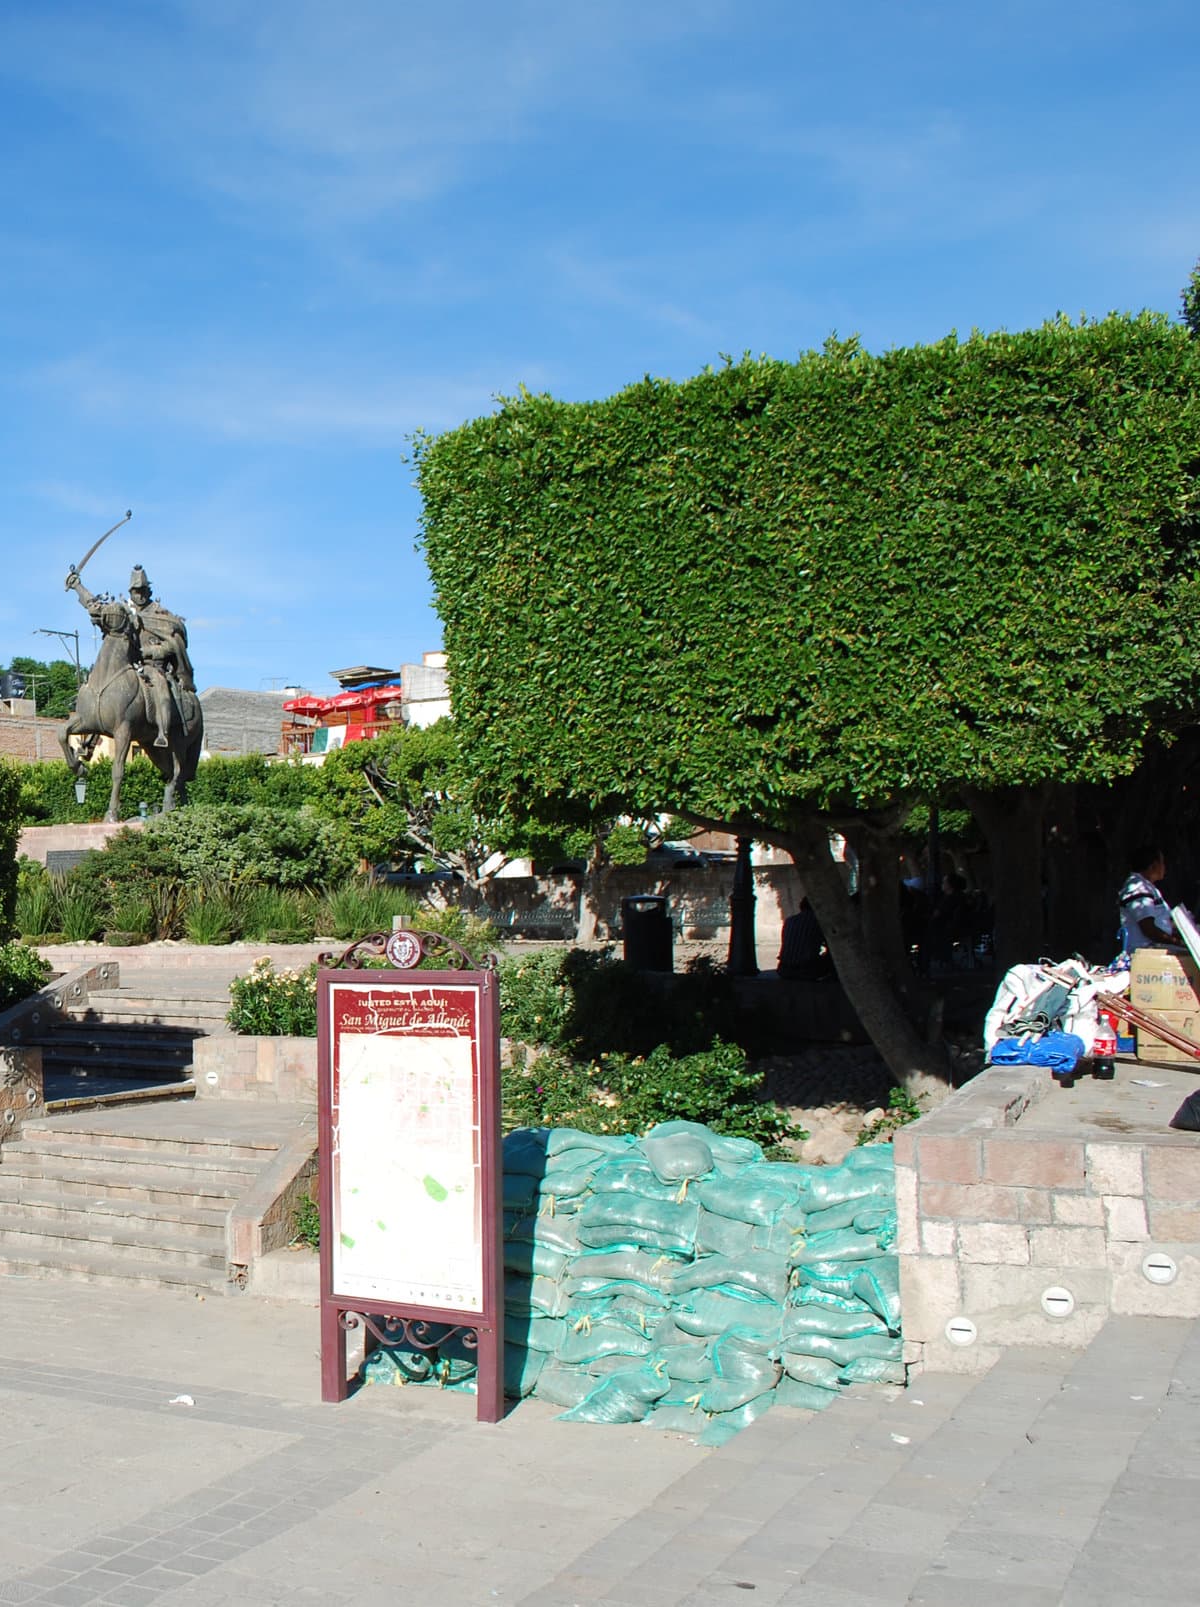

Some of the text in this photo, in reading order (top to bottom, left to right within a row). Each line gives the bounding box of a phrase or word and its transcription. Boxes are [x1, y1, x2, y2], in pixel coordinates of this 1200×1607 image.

[340, 1013, 471, 1029] San Miguel de Allende
